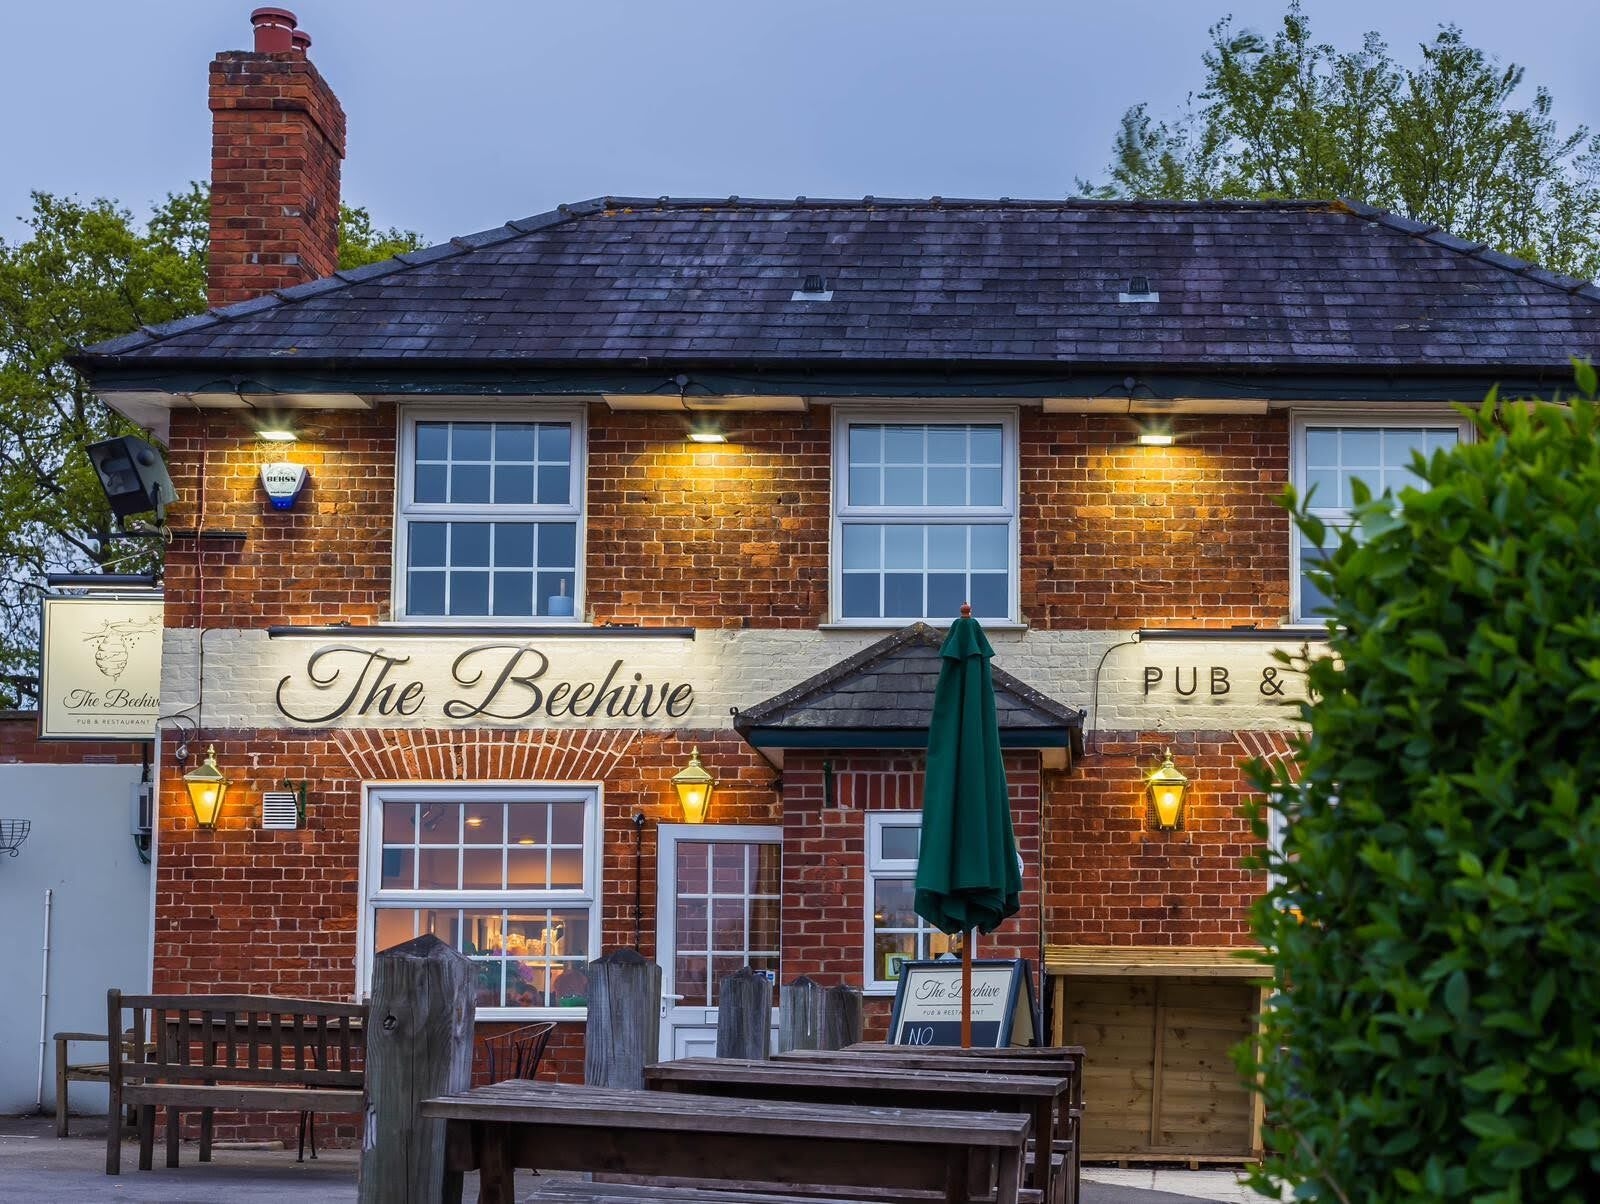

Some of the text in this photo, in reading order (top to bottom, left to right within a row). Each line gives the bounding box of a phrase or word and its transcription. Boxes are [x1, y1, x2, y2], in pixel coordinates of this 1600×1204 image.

[276, 642, 695, 723] The Beehive
[1144, 666, 1285, 696] PUB &
[63, 688, 100, 709] The
[915, 979, 946, 1000] The
[909, 1026, 934, 1045] NO
